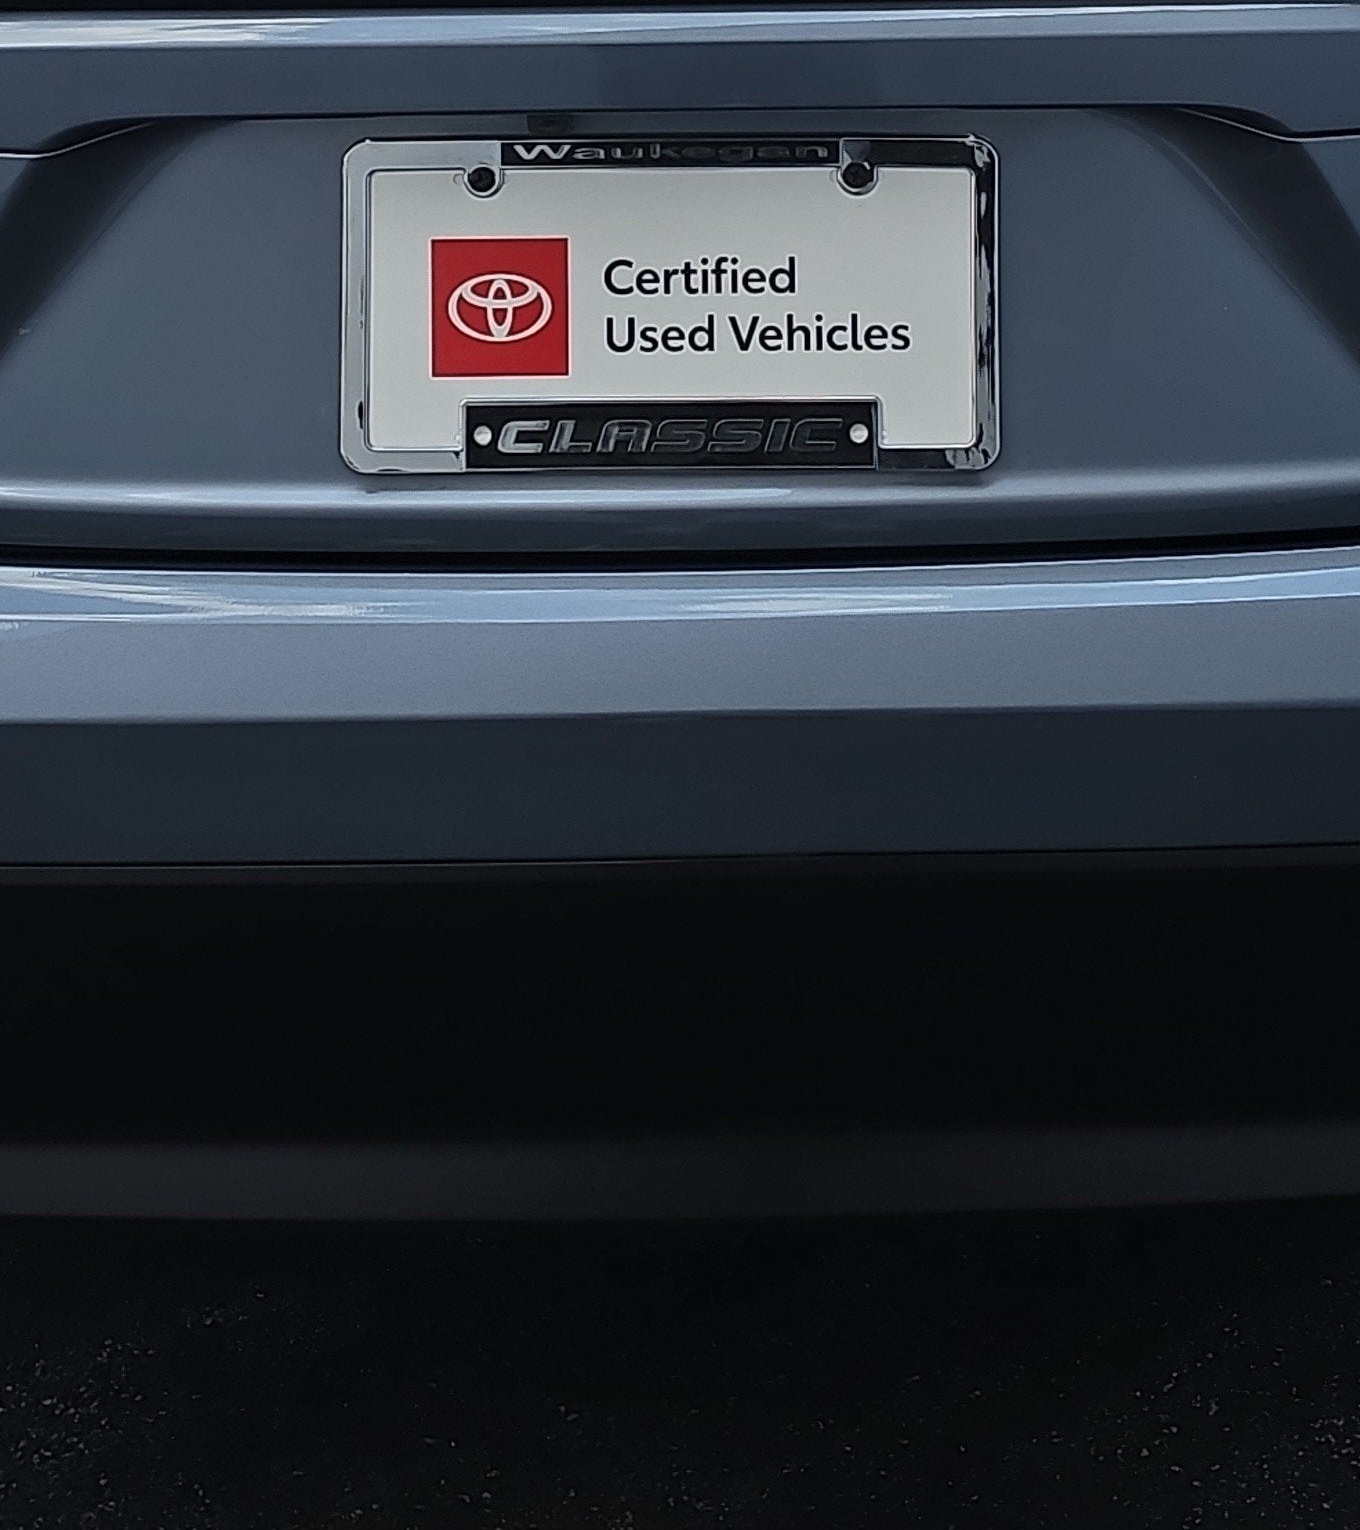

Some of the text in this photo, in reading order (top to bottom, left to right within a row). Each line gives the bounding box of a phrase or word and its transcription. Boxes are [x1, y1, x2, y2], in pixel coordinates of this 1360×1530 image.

[512, 141, 829, 162] Waukegan
[603, 256, 797, 296] Certified
[605, 314, 911, 353] Used Vehicles
[497, 418, 843, 455] CLASSIC
